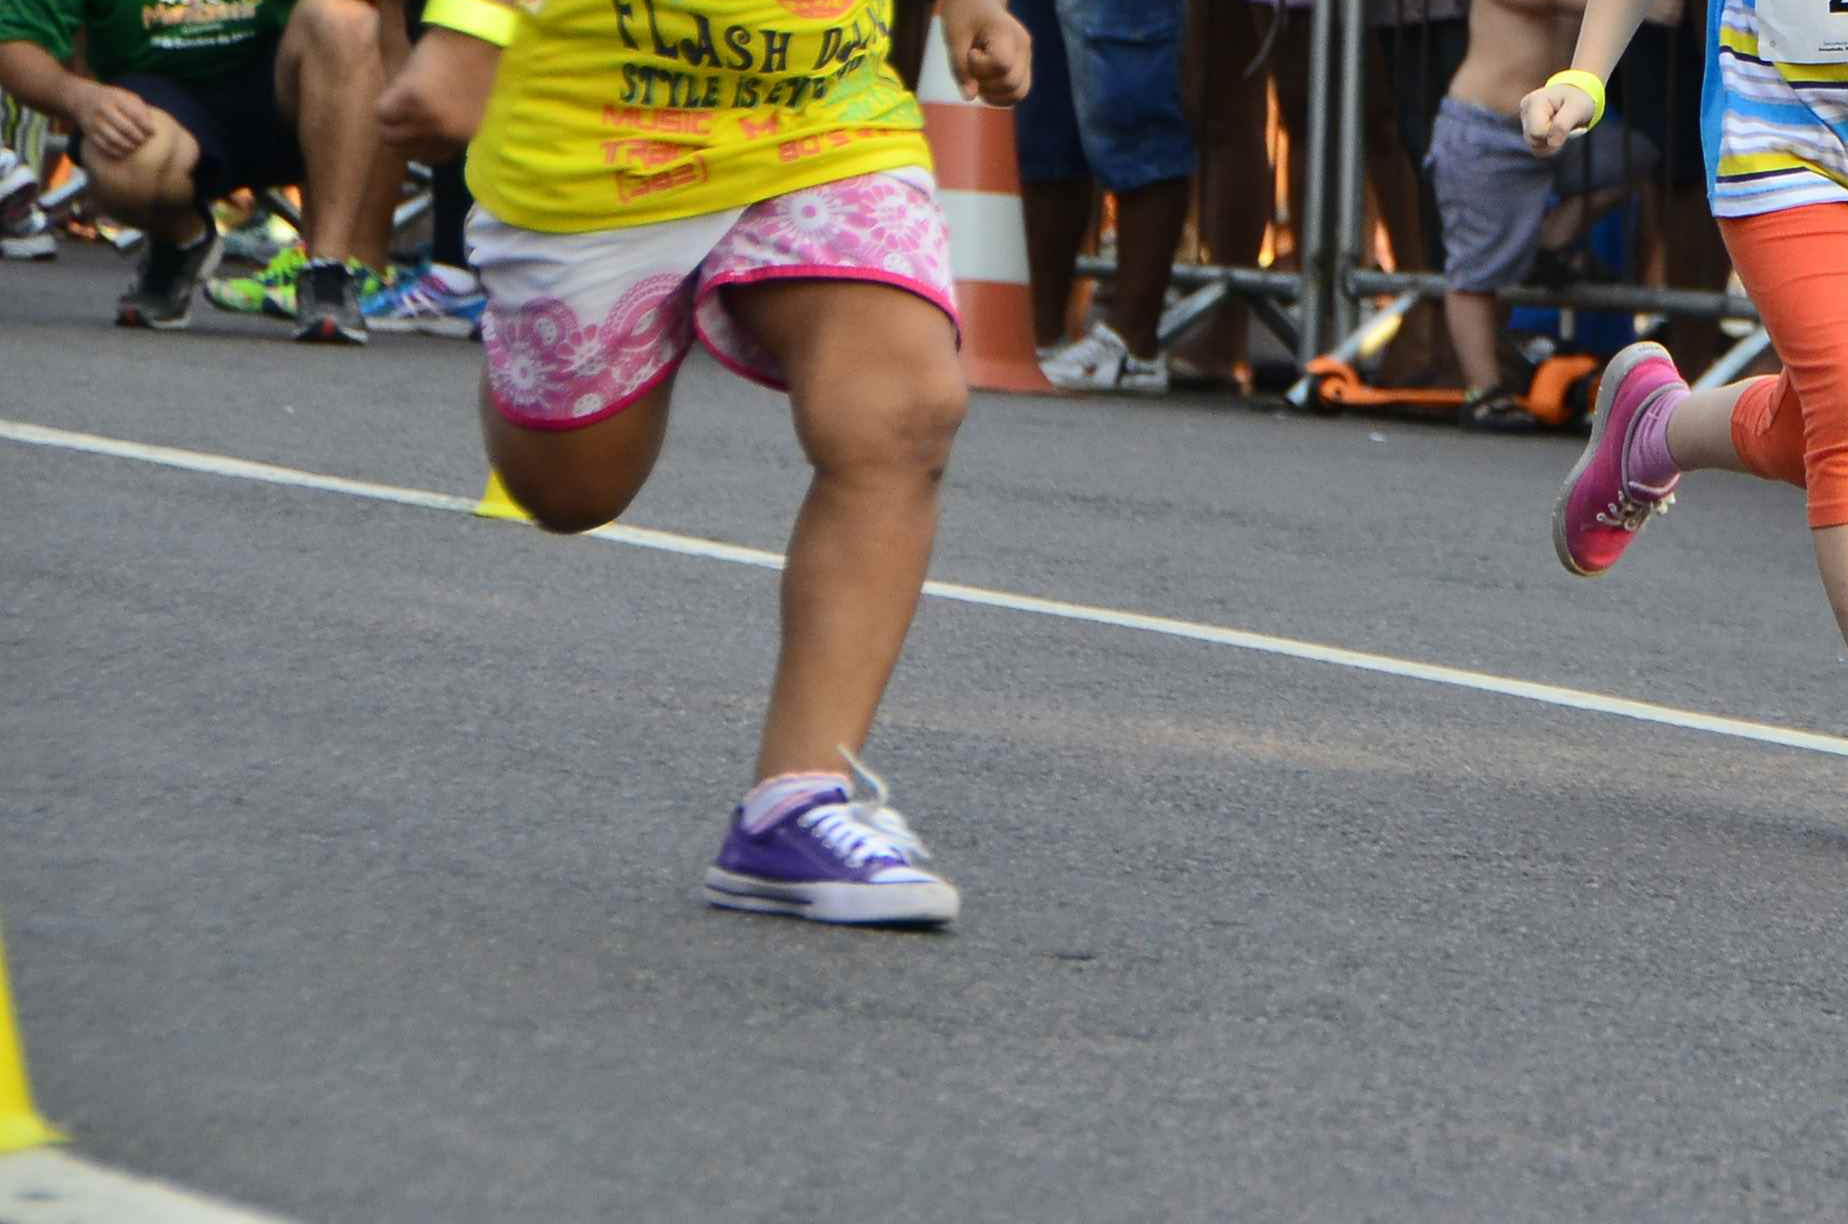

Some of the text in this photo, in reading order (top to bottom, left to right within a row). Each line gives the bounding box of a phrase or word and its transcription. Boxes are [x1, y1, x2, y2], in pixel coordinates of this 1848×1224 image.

[620, 62, 721, 109] STYLE
[732, 75, 763, 108] IS
[602, 103, 714, 136] MUSIC
